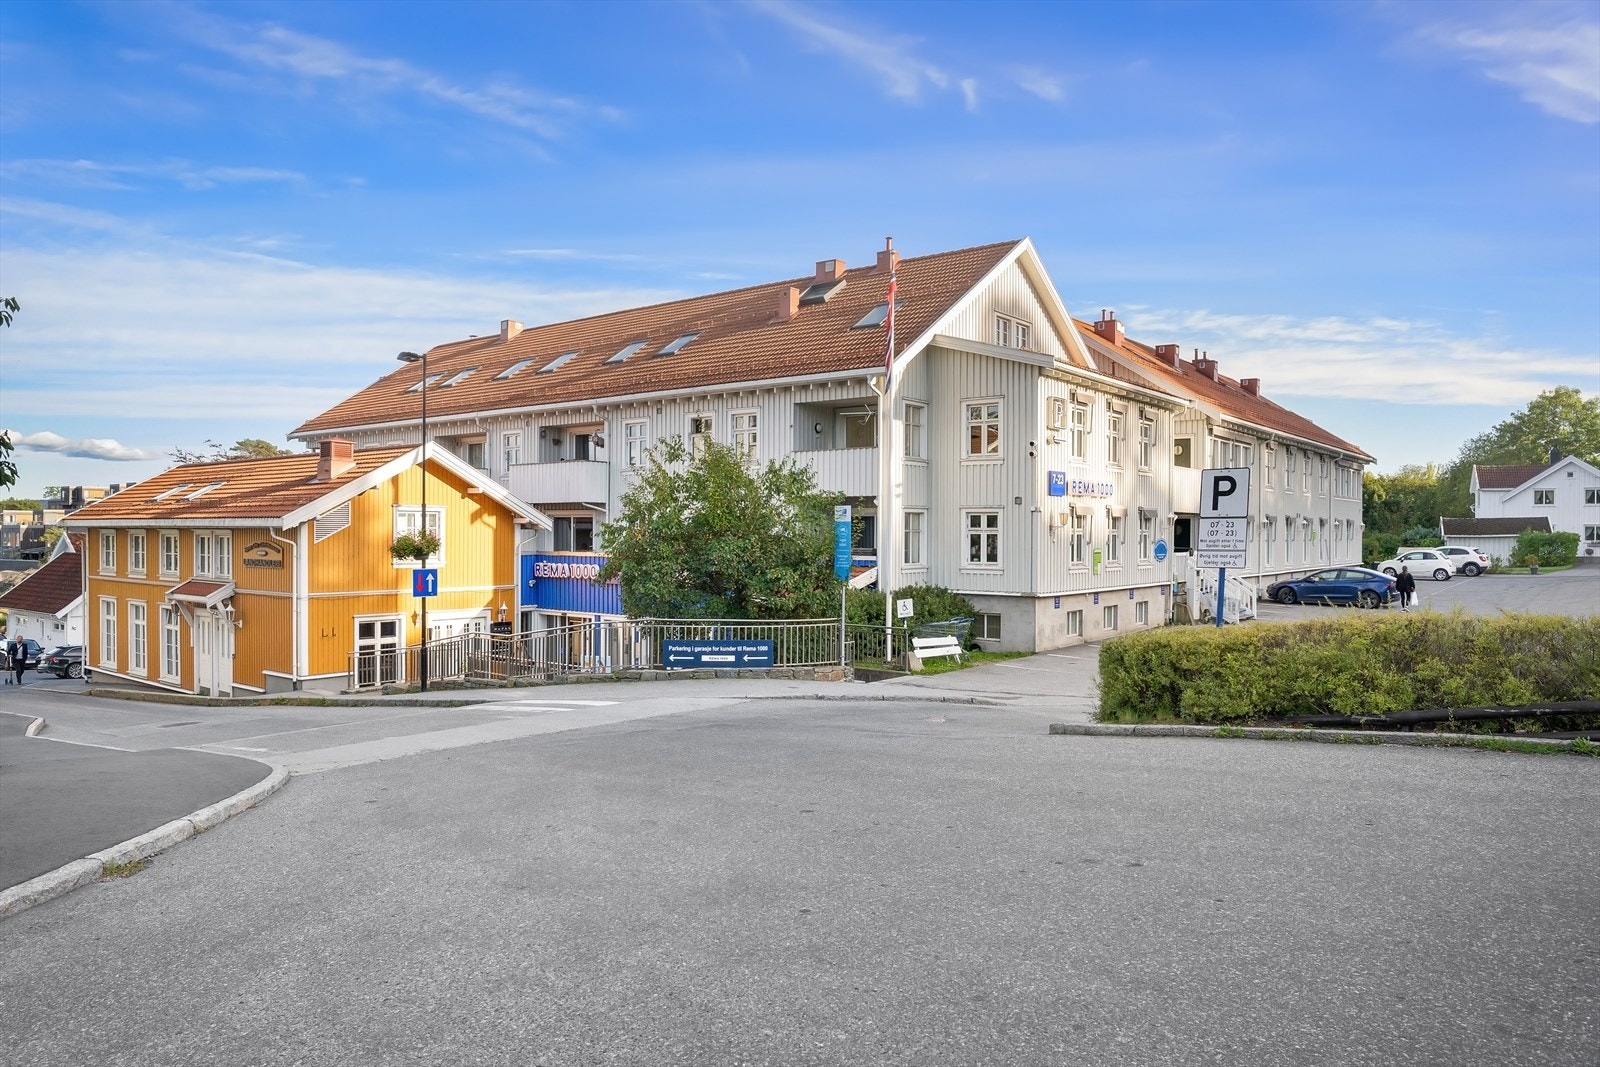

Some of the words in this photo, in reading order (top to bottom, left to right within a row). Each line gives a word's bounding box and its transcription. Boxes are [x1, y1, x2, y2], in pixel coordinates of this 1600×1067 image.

[1052, 473, 1064, 485] 7-23
[1072, 480, 1095, 494] REMA
[1097, 482, 1114, 496] 1000
[1212, 475, 1237, 511] P
[1207, 529, 1219, 537] (07
[1225, 529, 1237, 537] 23)
[534, 562, 569, 578] REMA
[570, 563, 600, 579] 1000
